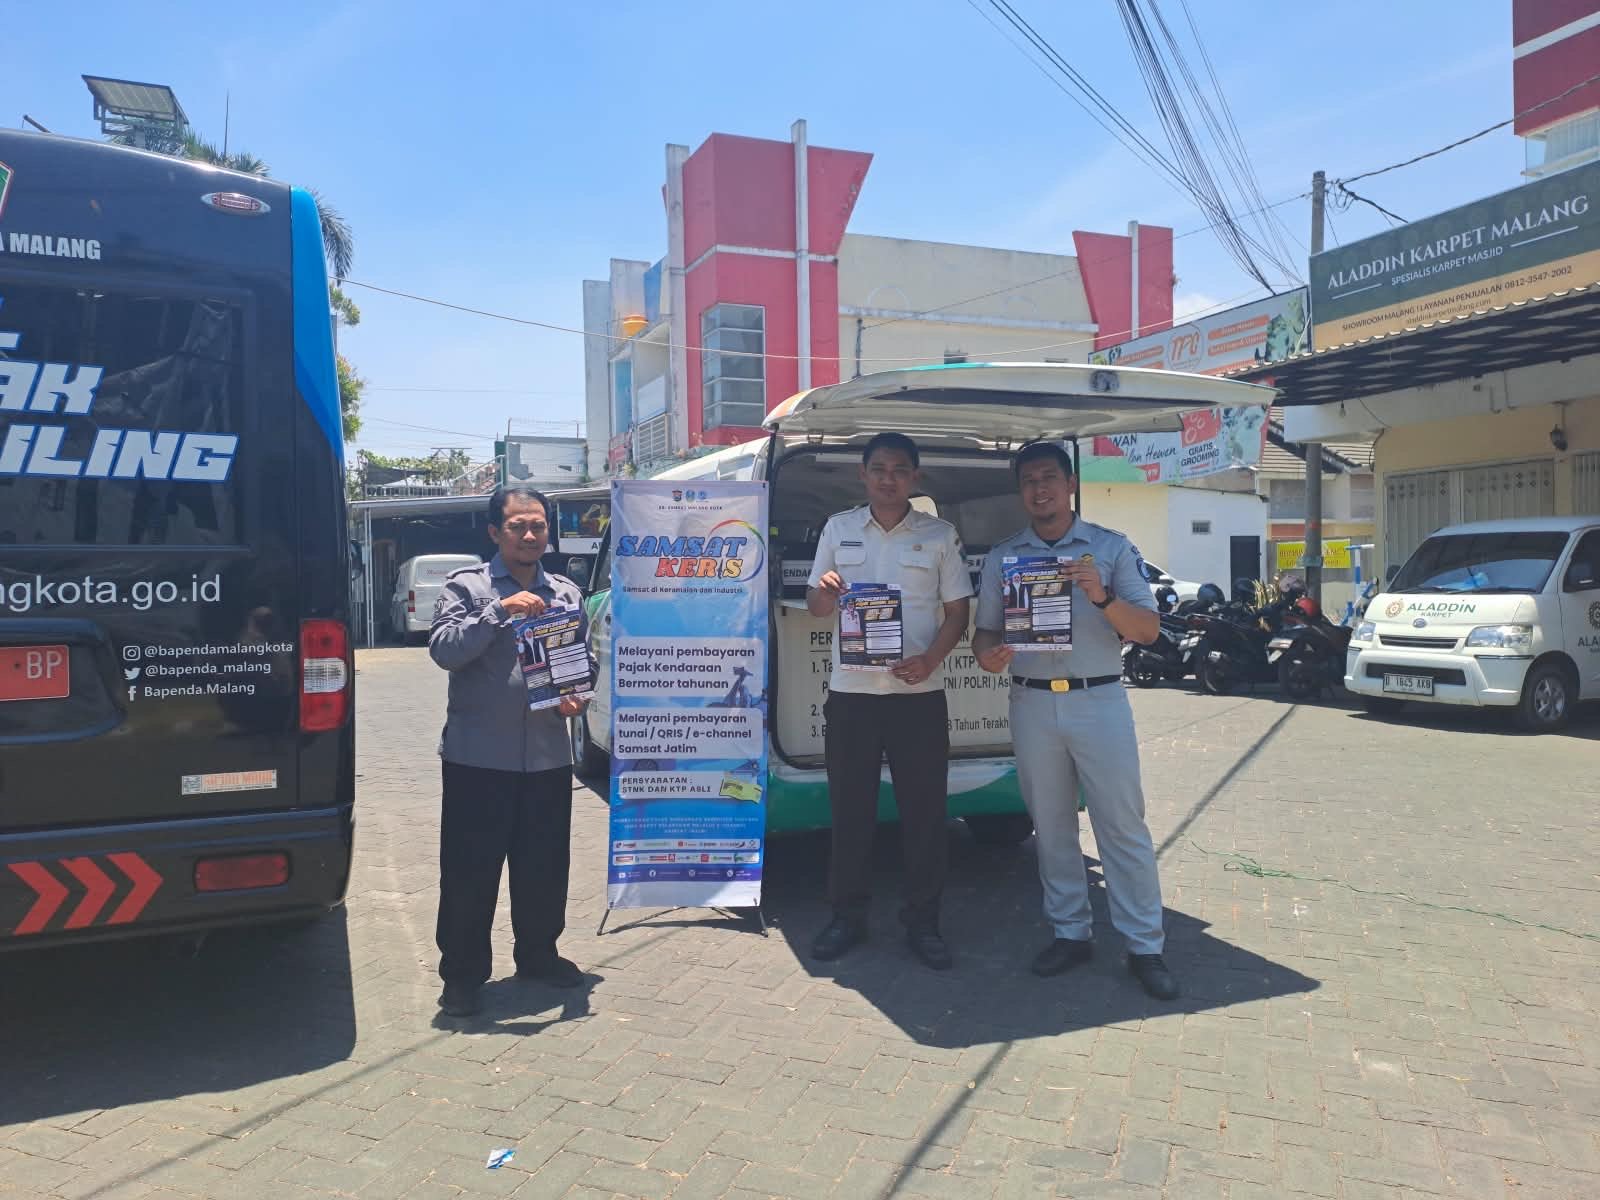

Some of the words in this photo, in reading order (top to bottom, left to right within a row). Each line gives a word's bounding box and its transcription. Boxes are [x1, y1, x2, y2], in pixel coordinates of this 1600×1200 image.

[10, 232, 101, 260] MALANG
[1328, 252, 1405, 290] ALADDIN
[1411, 226, 1486, 264] KARPET
[1492, 195, 1589, 240] MALANG
[1391, 266, 1431, 286] SPESIALIS
[1432, 255, 1466, 273] KARPET
[1468, 246, 1503, 264] MASJID
[1342, 314, 1384, 330] SHOWROOM
[1384, 307, 1415, 321] MALANG
[1420, 295, 1455, 311] LAYANAN
[1456, 285, 1502, 302] PENJUALAN
[1188, 441, 1213, 457] GRATIS
[1181, 449, 1220, 467] GROOMING
[616, 535, 747, 558] SAMSAT
[623, 586, 650, 594] Samsat
[714, 586, 743, 595] Industri
[1406, 602, 1477, 613] ALADDIN
[144, 641, 293, 659] @bapendamalangkota
[618, 646, 673, 659] Melayani
[676, 646, 755, 659] pembayaran
[27, 650, 62, 679] BP
[145, 661, 272, 678] @bapenda_malang
[618, 662, 651, 674] Pajak
[654, 662, 722, 673] Kendaraan
[955, 655, 976, 670] KTP
[618, 678, 674, 689] Bermotor
[677, 678, 729, 689] tahunan
[964, 676, 991, 689] POLRI
[144, 682, 256, 700] Bapenda.Malang
[618, 713, 670, 725] Melayani
[673, 713, 747, 726] pembayaran
[955, 717, 980, 731] Tahun
[619, 728, 648, 738] tunai
[657, 728, 683, 739] QRIS
[693, 728, 752, 738] e-channel
[618, 744, 662, 754] Samsat
[664, 743, 697, 754] Jatim
[622, 777, 688, 785] PERSYARATAN
